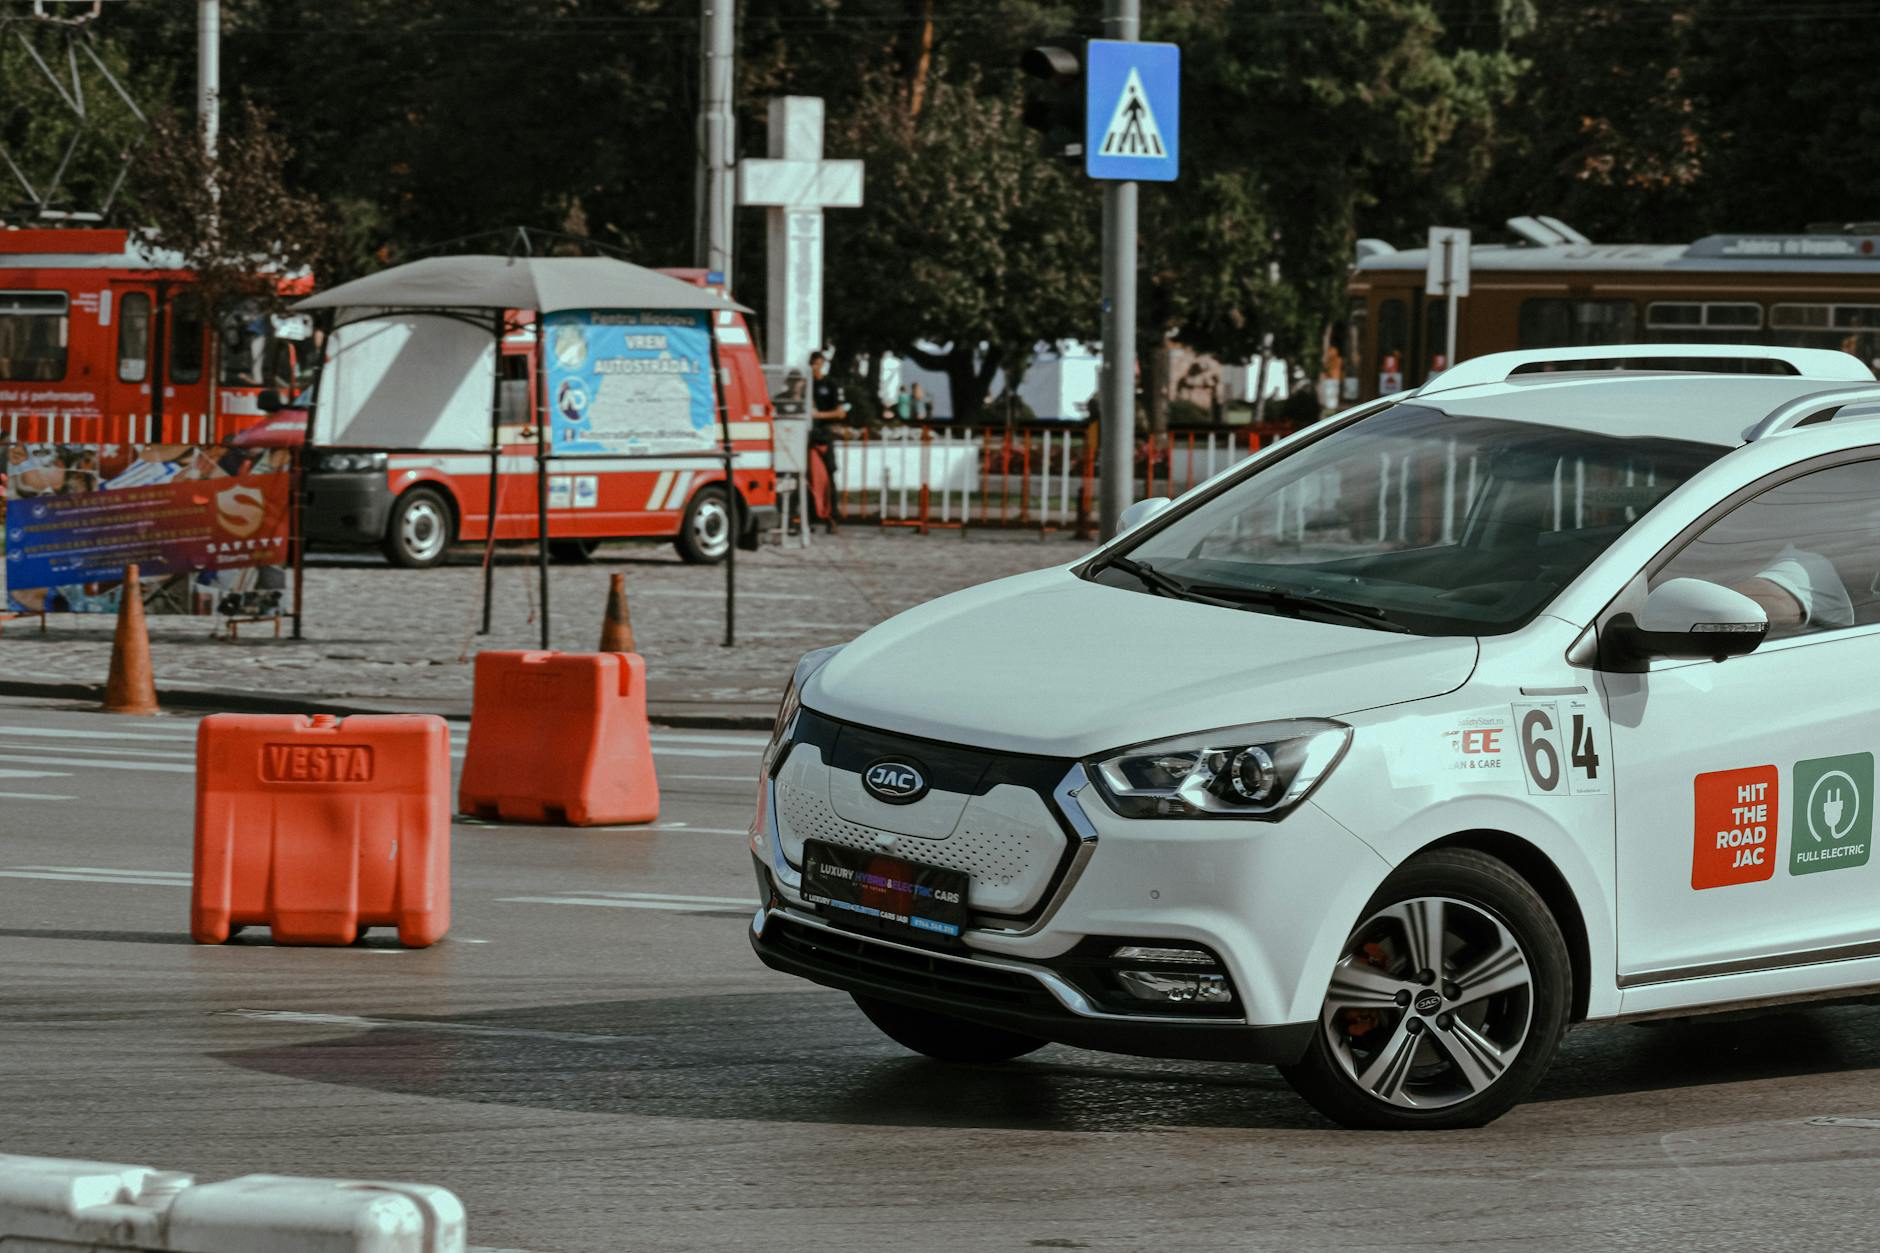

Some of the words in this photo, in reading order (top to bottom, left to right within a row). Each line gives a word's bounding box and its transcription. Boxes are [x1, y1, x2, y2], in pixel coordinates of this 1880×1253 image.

[206, 536, 283, 554] SAFETY
[270, 746, 370, 780] VESTA
[1478, 759, 1502, 769] CARE
[871, 768, 915, 789] JAC
[1737, 783, 1768, 804] HIT
[1731, 804, 1767, 826] THE
[1715, 826, 1767, 849] ROAD
[1732, 847, 1765, 868] JAC
[1796, 850, 1820, 863] FULL
[1820, 843, 1865, 860] ELECTRIC
[820, 863, 854, 880] LUXURY
[933, 889, 960, 904] CARS
